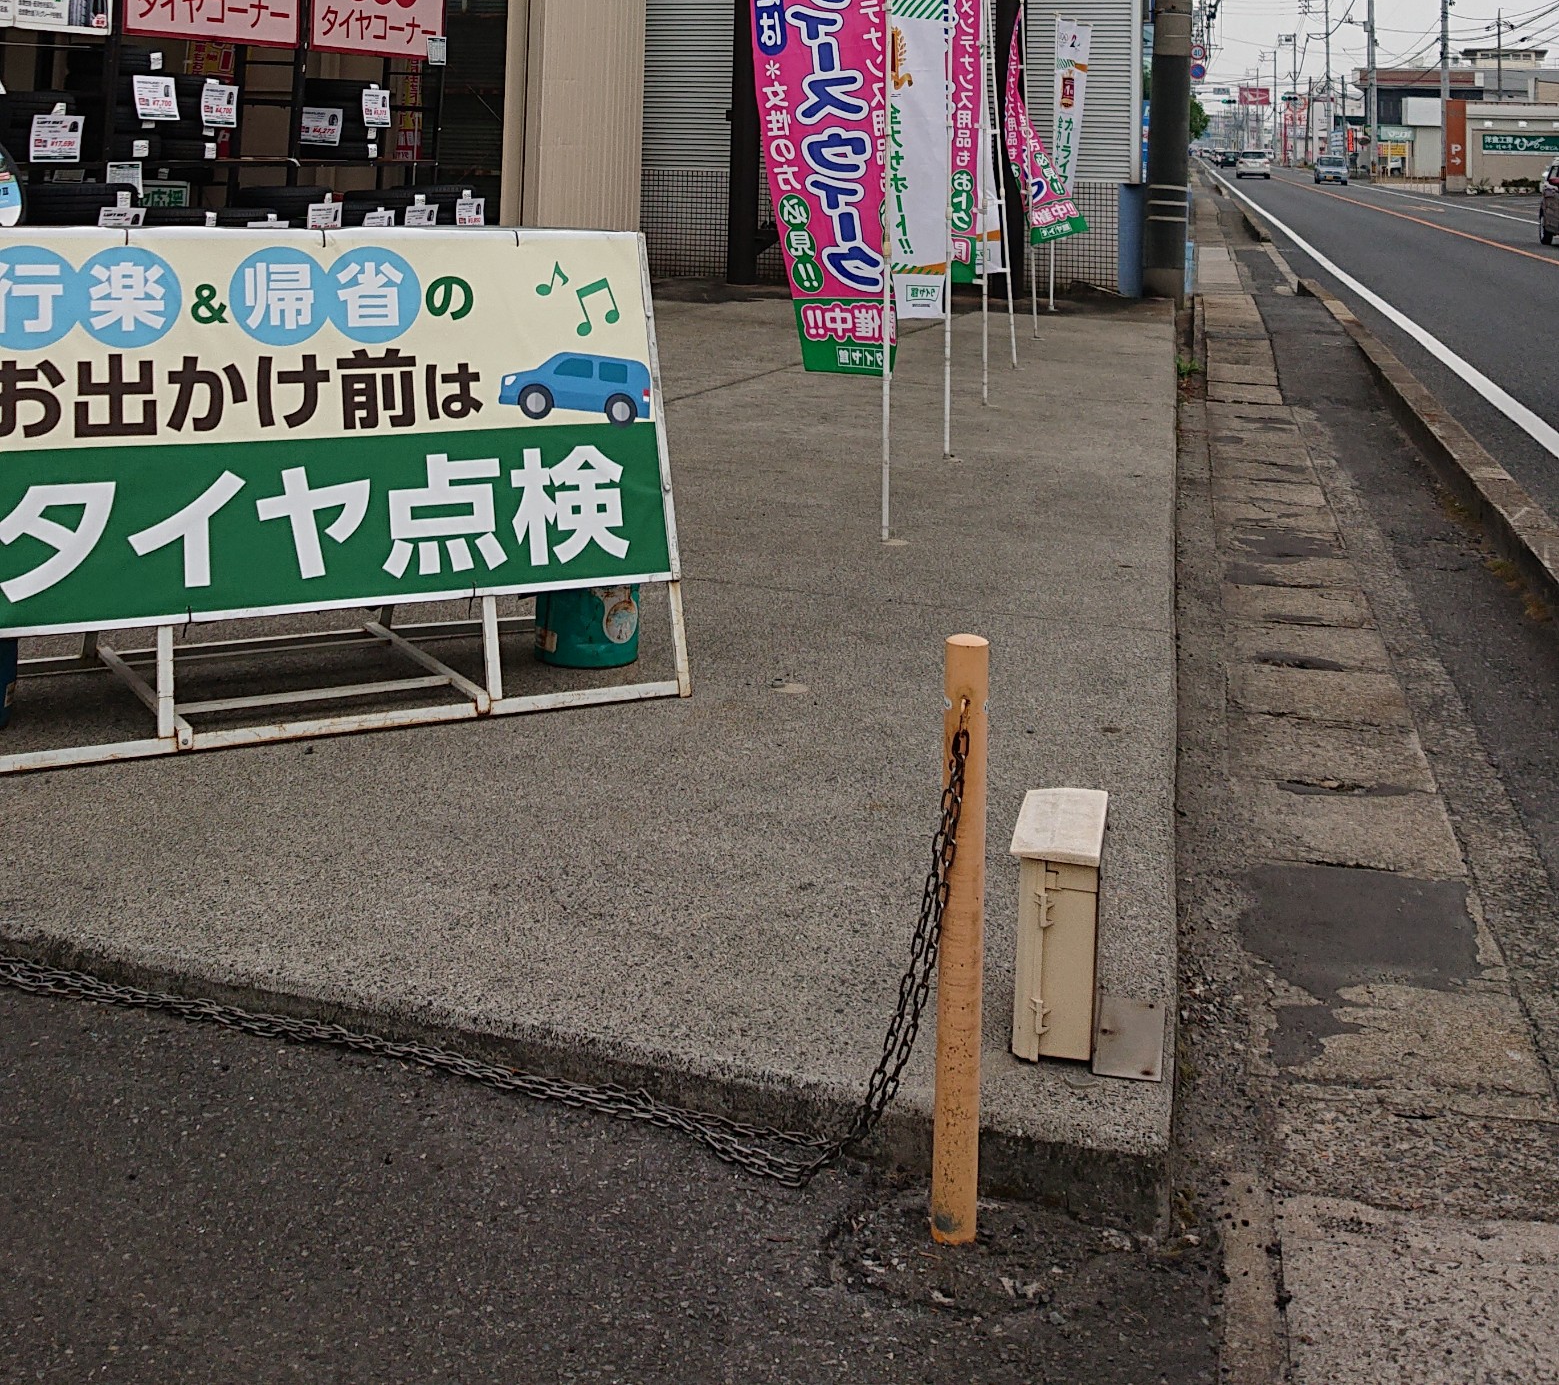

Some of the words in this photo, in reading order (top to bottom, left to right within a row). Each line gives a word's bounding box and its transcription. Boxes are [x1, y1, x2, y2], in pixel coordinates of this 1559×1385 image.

[322, 5, 437, 45] タイヤコーナー
[1193, 49, 1202, 57] 40
[1451, 144, 1462, 155] P
[0, 349, 484, 438] お出かけ前は
[0, 445, 631, 603] タイヤ点検
